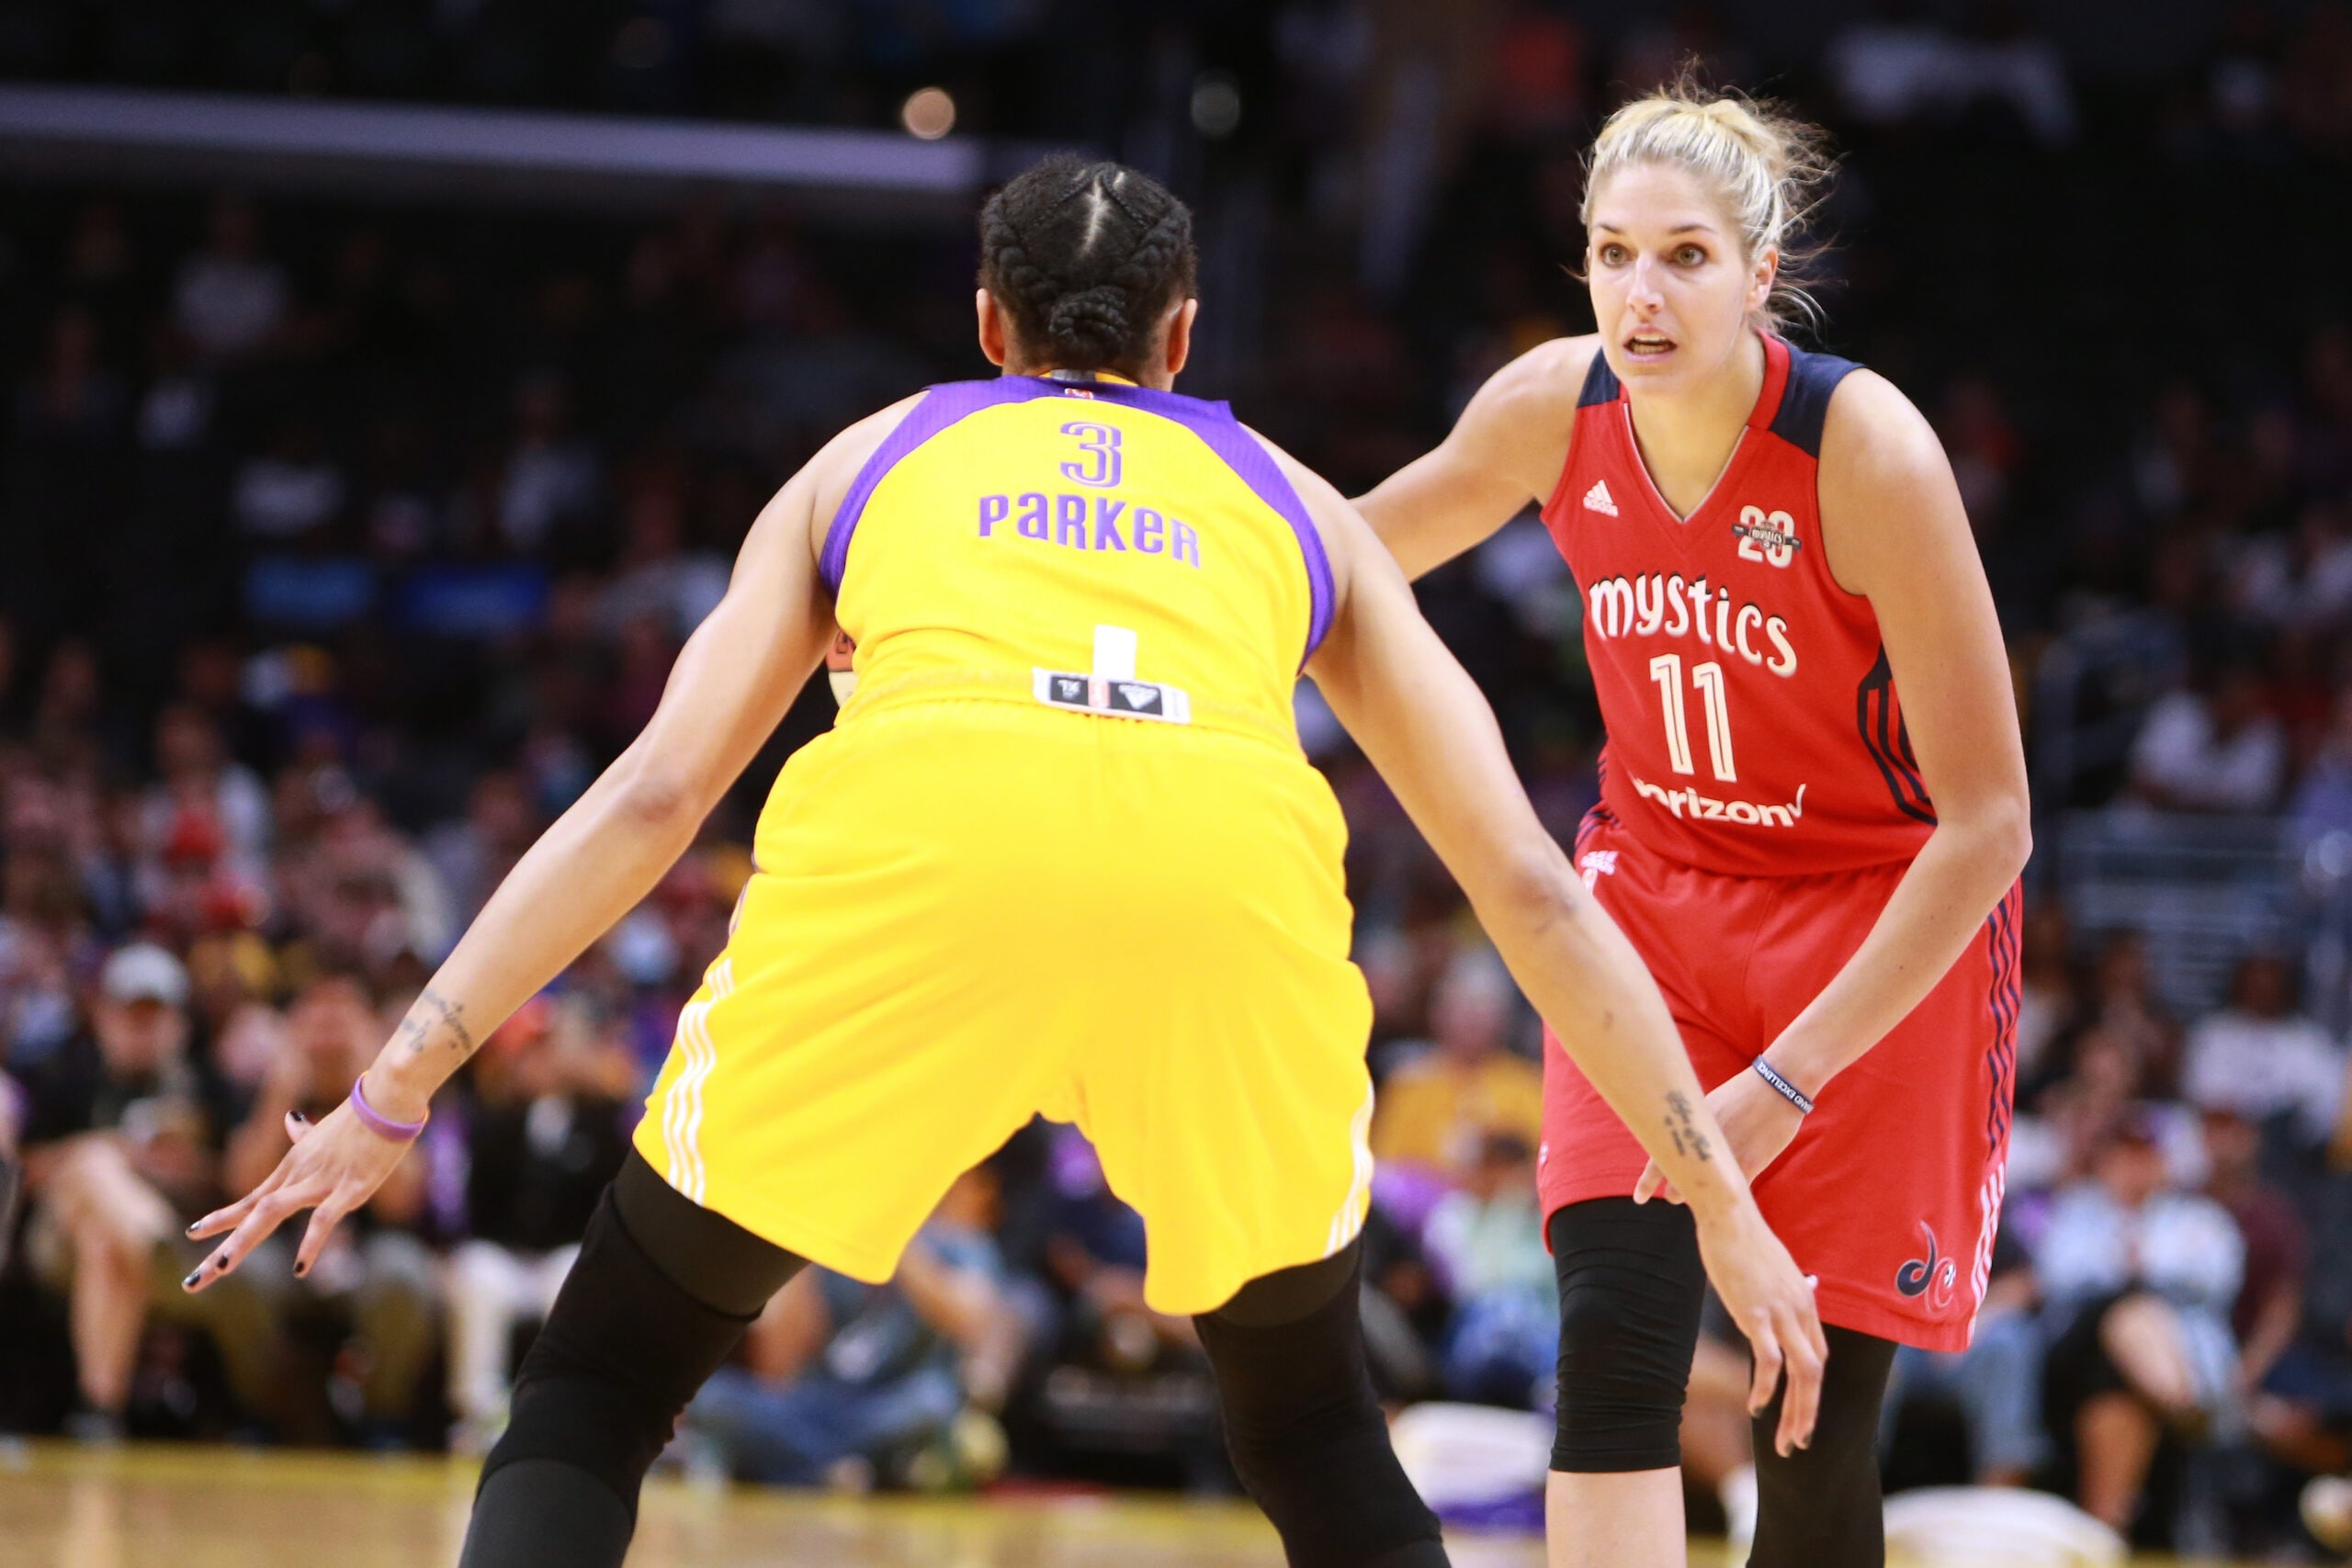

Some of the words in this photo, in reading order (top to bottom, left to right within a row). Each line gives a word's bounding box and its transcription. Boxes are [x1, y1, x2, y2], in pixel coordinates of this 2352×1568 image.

[1060, 421, 1122, 488] 3
[1589, 570, 1798, 678] mystics
[1649, 653, 1737, 783] 11
